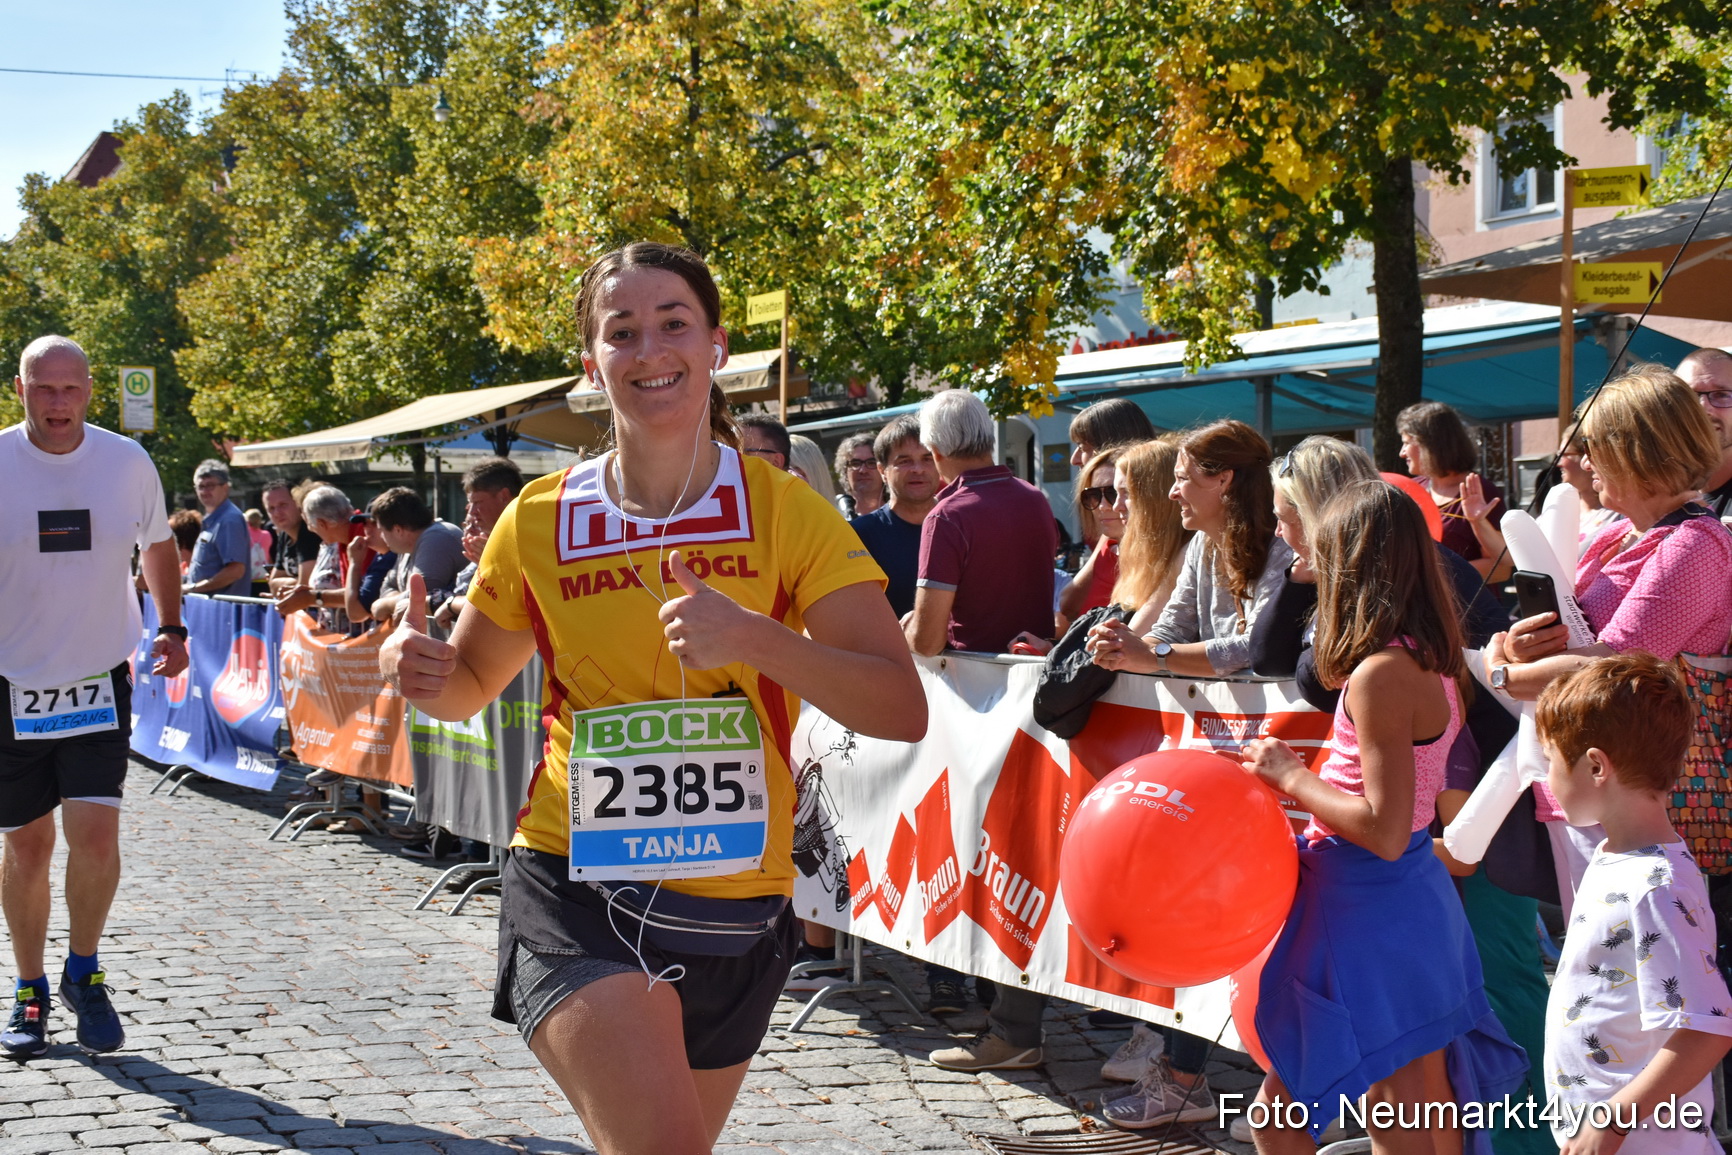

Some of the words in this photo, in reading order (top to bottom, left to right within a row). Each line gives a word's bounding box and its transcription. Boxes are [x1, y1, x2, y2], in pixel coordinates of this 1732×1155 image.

[1583, 190, 1621, 205] ausgabe
[1582, 270, 1643, 281] Kleiderbeutel-
[1593, 285, 1630, 298] ausgabe
[559, 564, 644, 601] MAX
[1563, 595, 1589, 637] stadtwerke
[1570, 624, 1585, 645] bieten
[23, 684, 100, 714] 2717
[33, 710, 108, 734] WOLFGANG
[586, 706, 750, 753] BOCK
[1201, 717, 1273, 736] BINDESTRICKE
[748, 764, 757, 774] D
[593, 762, 746, 818] 2385
[1062, 792, 1071, 816] 1929
[1129, 797, 1189, 822] energie
[1058, 816, 1067, 834] Seit
[622, 832, 723, 859] TANJA
[918, 855, 958, 919] Braun
[967, 827, 1046, 930] Braun
[934, 899, 949, 916] Sicher
[989, 900, 1005, 926] Sicher
[1004, 918, 1015, 934] ist
[1013, 926, 1037, 951] sicher
